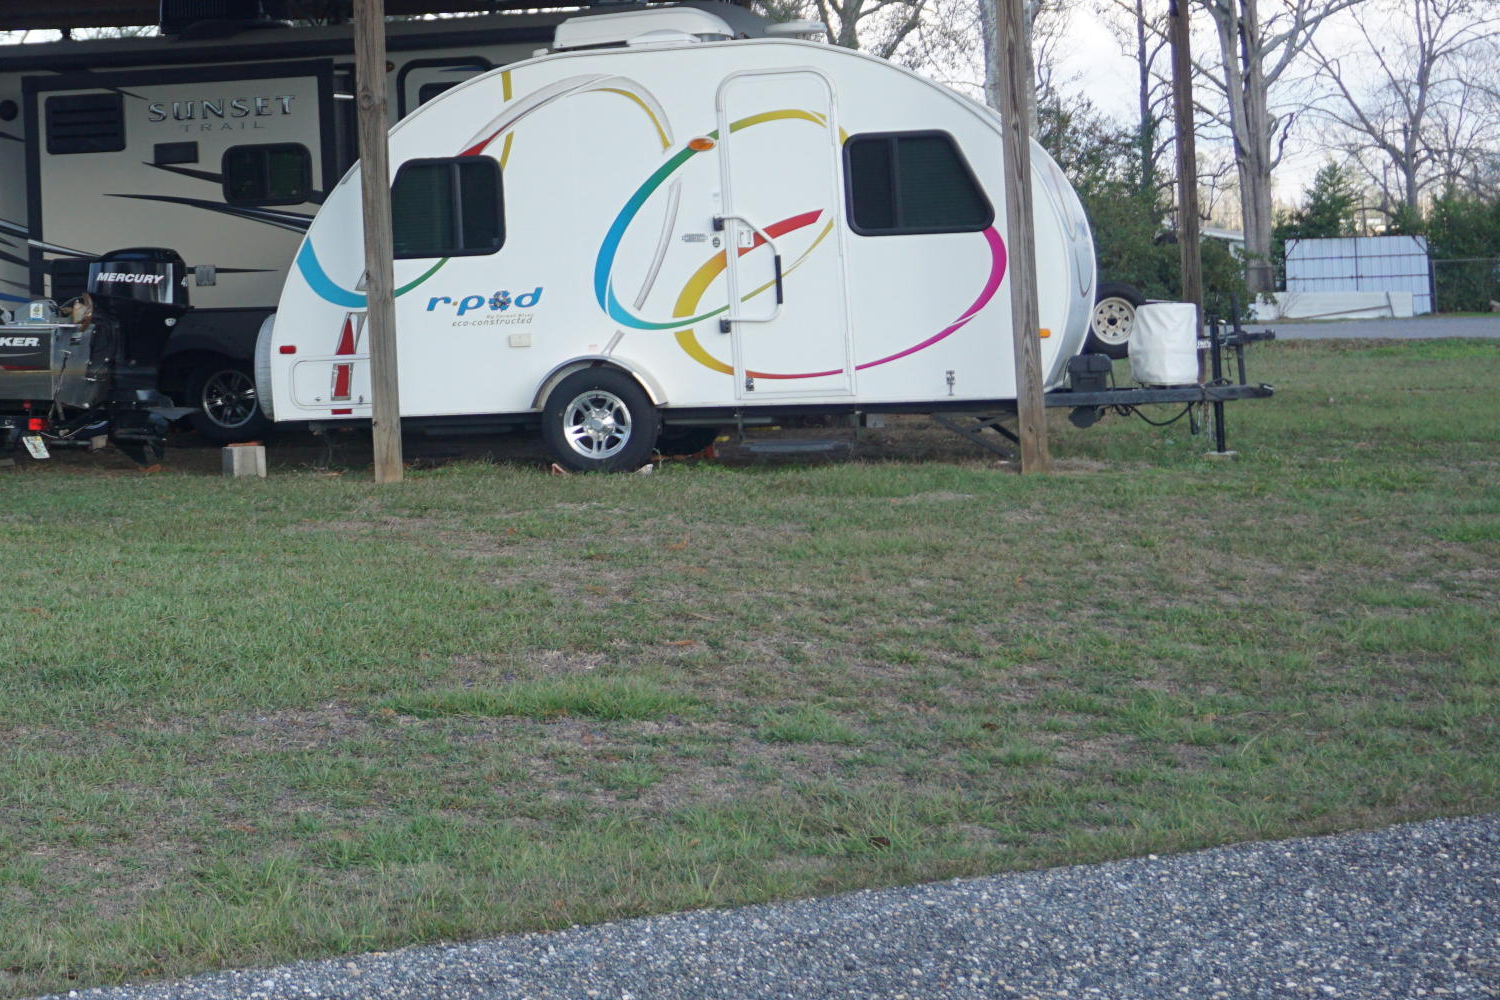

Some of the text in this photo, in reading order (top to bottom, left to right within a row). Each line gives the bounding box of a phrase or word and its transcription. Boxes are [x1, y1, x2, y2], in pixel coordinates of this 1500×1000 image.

[148, 95, 296, 122] SUNSET
[181, 121, 265, 133] TRAIL
[96, 272, 165, 285] MERCURY
[452, 317, 533, 327] eco-constructed
